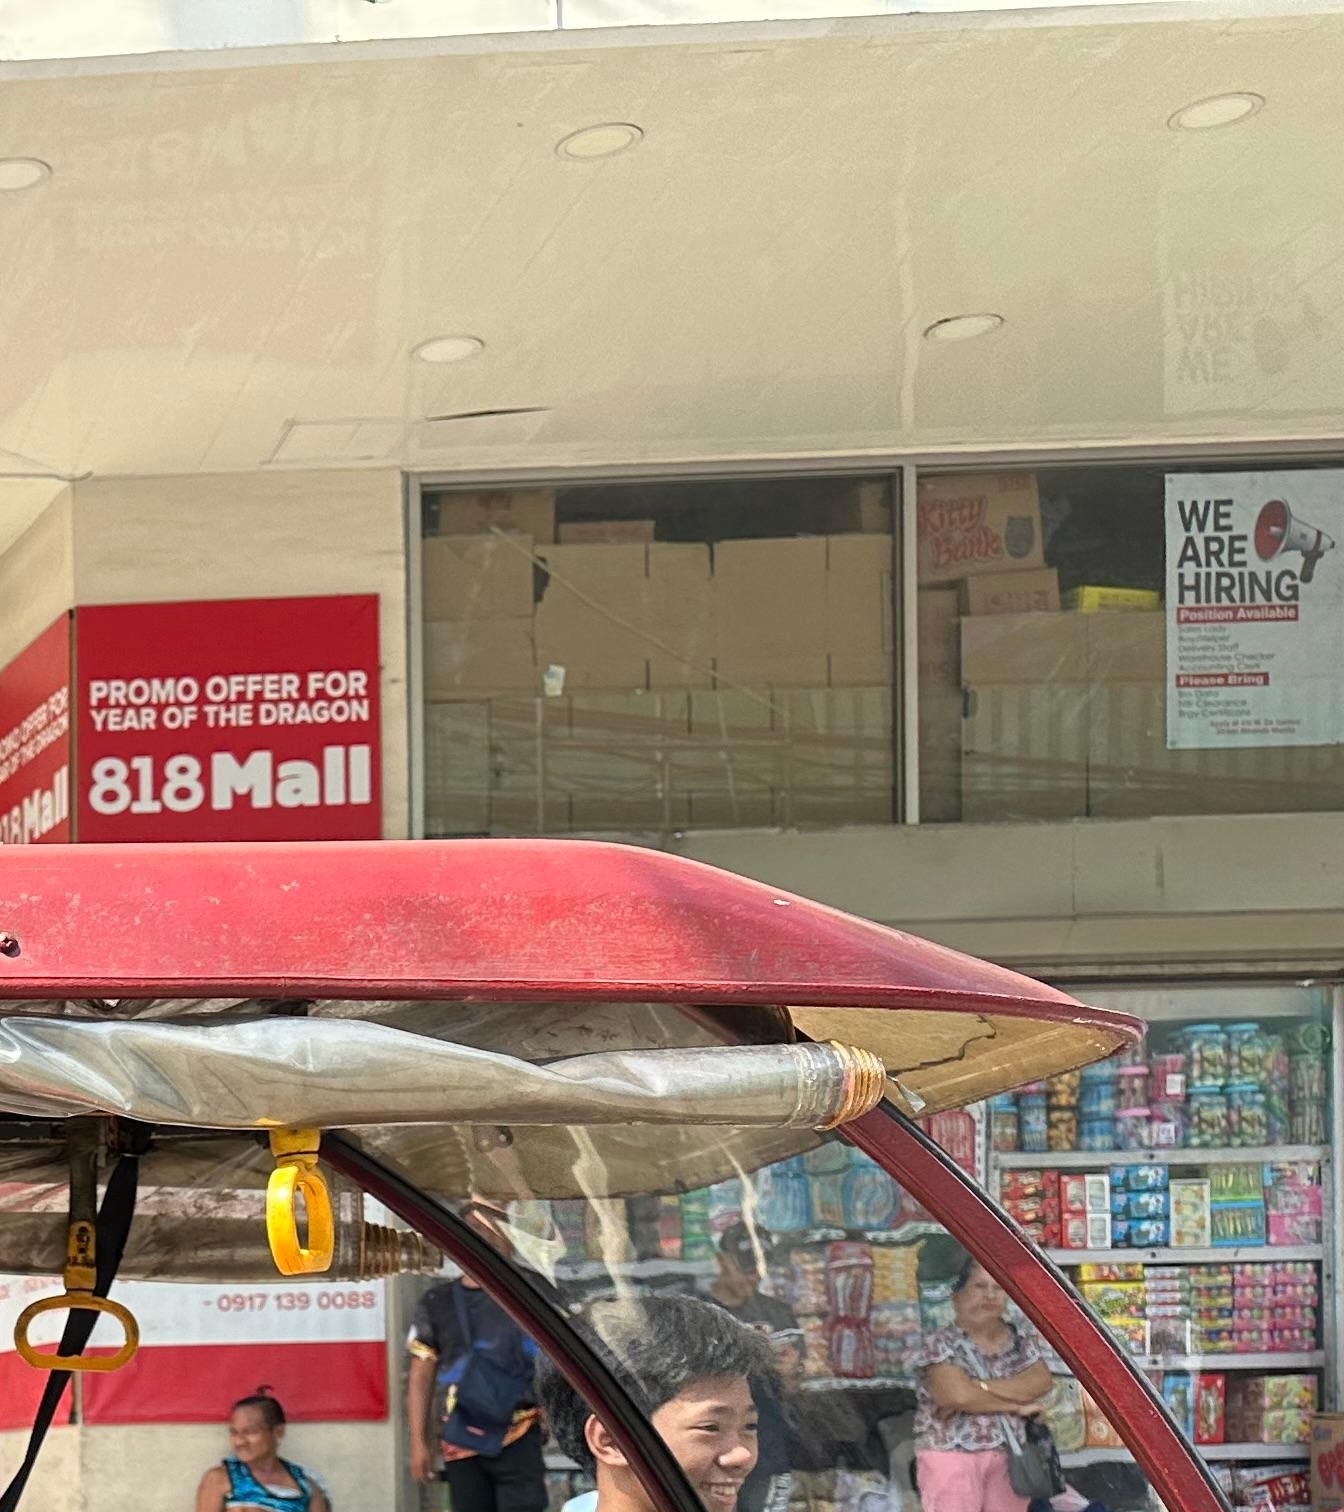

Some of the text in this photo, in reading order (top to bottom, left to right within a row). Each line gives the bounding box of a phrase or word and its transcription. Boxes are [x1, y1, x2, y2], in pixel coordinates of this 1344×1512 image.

[1177, 499, 1233, 533] WE
[1177, 534, 1248, 569] ARE
[1177, 569, 1299, 604] HIRING
[1180, 606, 1296, 622] Position Available
[88, 670, 368, 707] PROMO OFFER FOR
[1180, 674, 1264, 686] Please Bring
[89, 698, 371, 732] YEAR OF THE DRAGON
[217, 1293, 269, 1312] 0917
[274, 1291, 311, 1311] 139
